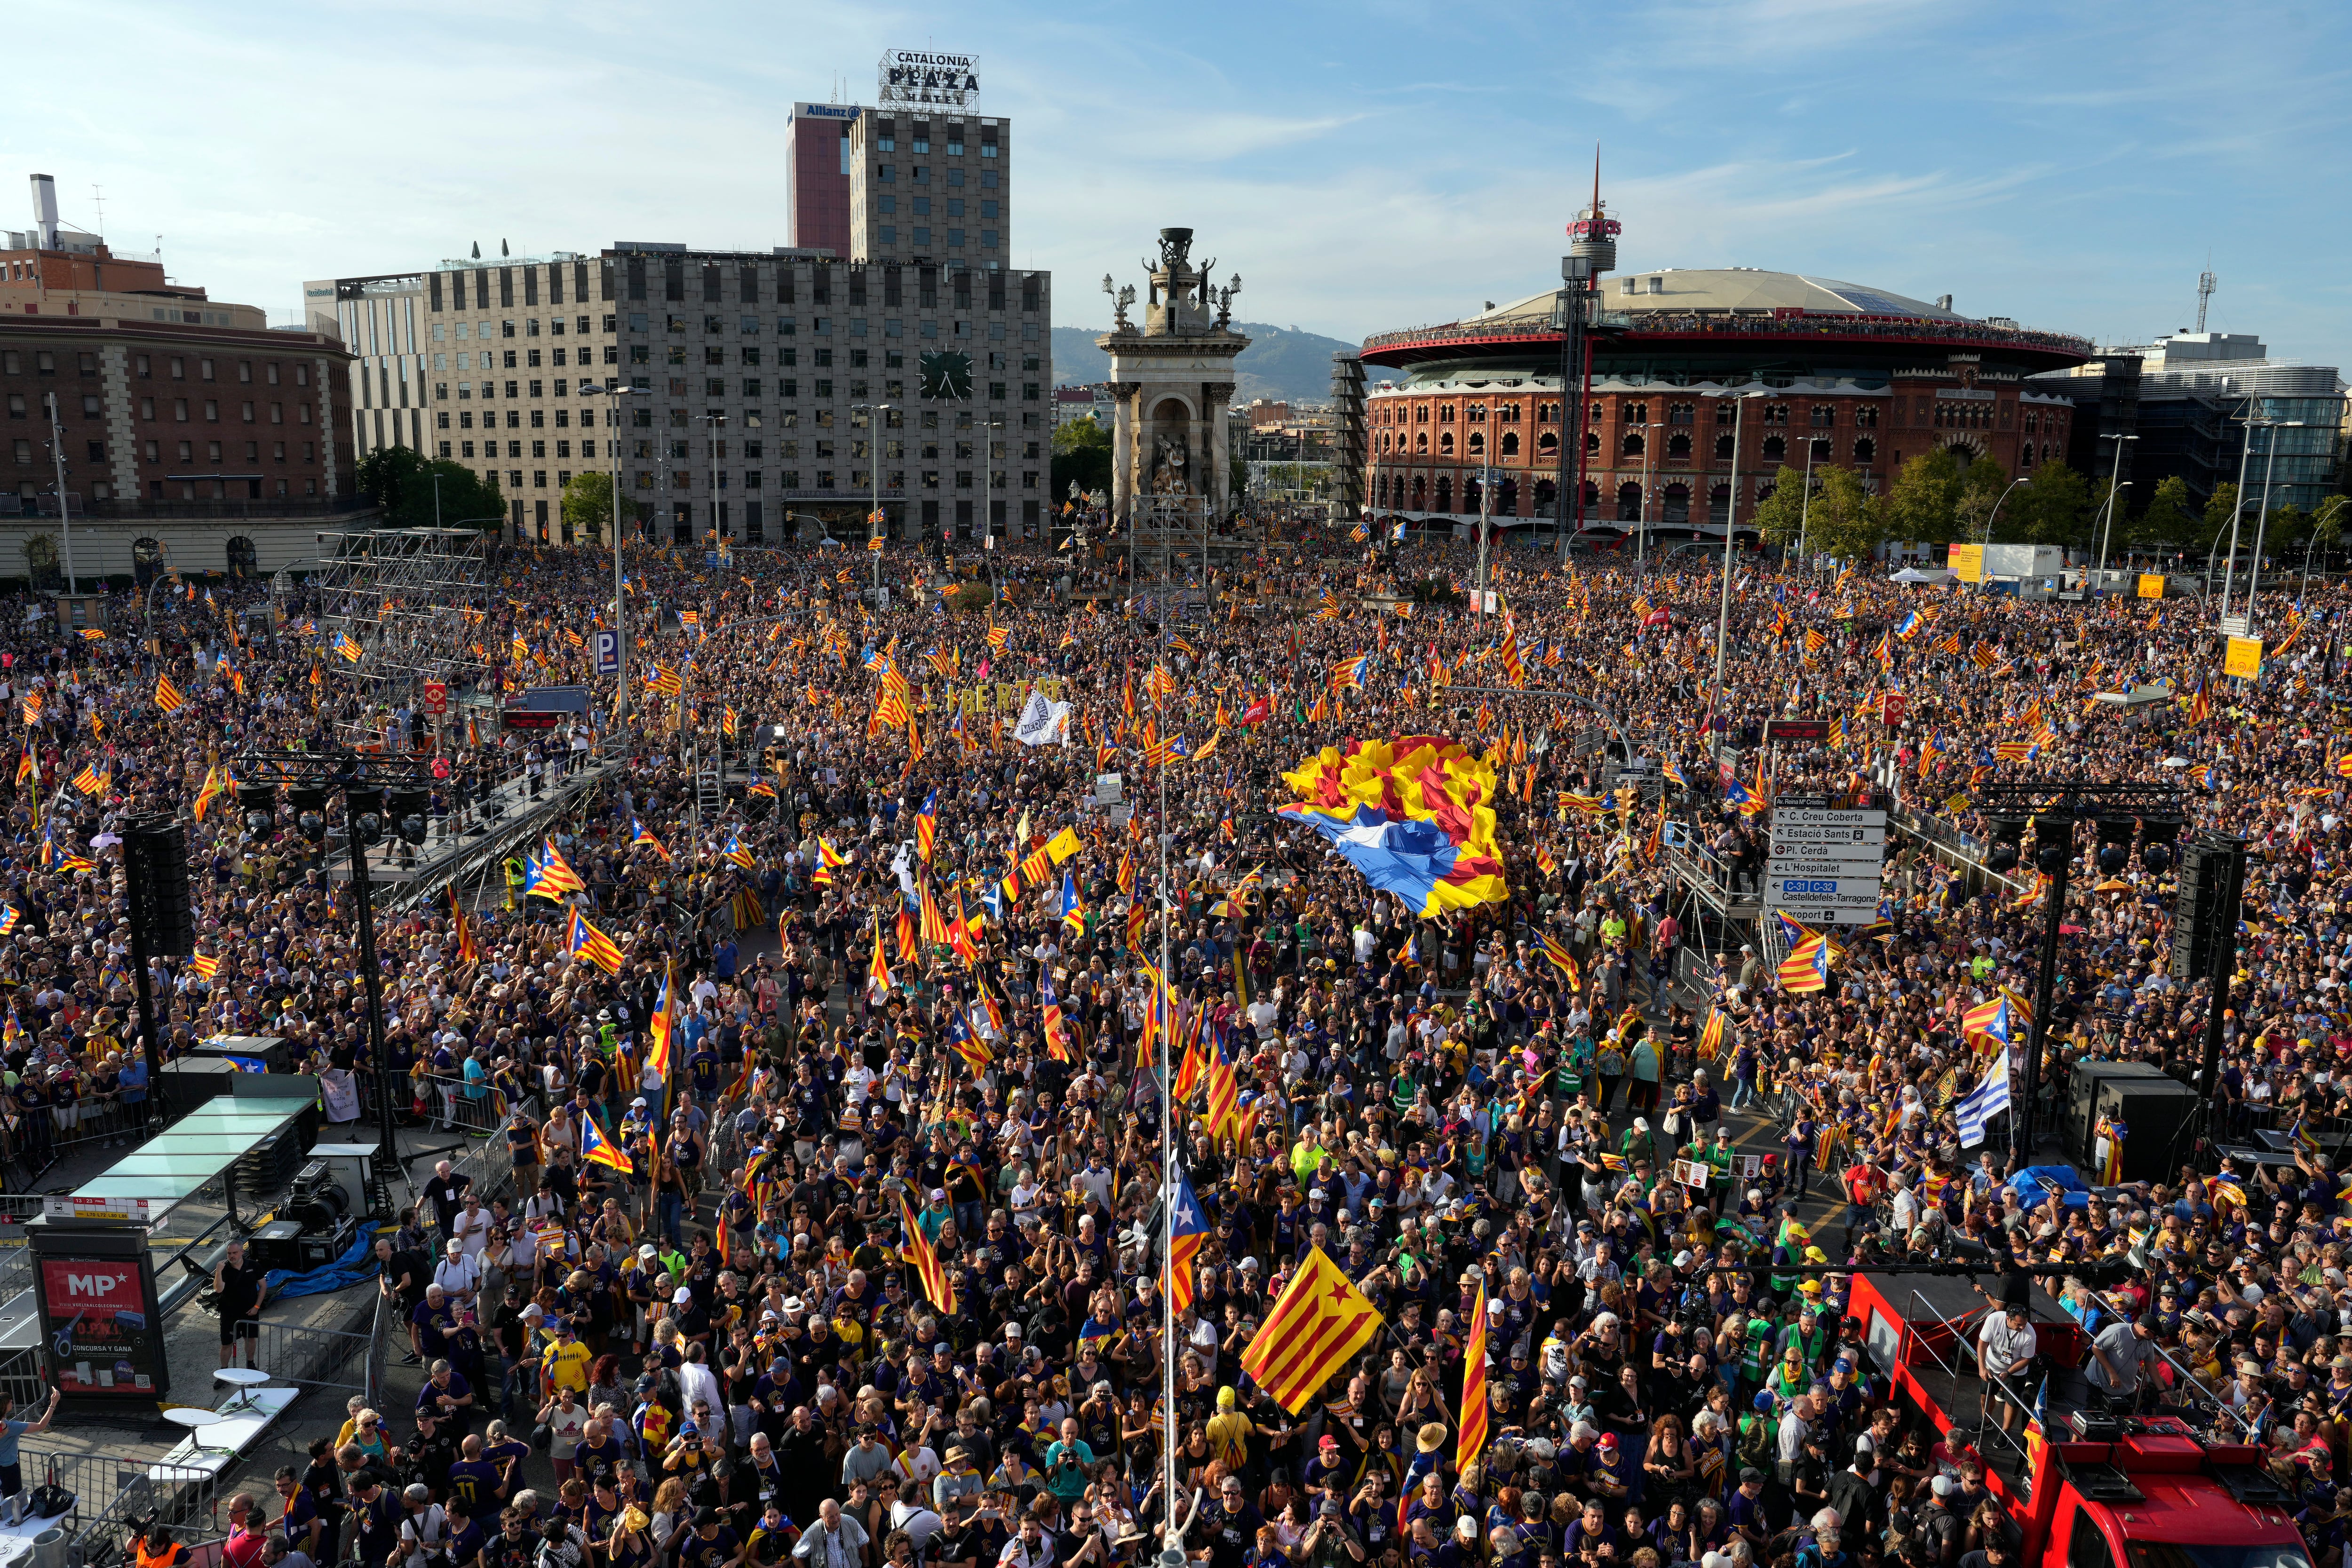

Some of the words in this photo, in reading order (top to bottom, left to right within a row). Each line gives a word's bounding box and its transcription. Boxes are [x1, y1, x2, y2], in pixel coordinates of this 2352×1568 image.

[898, 52, 970, 66] CATALONIA
[900, 64, 968, 74] BARCELONA
[890, 68, 979, 91] PLAZA
[908, 93, 962, 104] HOTEL
[807, 105, 846, 117] Allianz
[598, 634, 614, 663] P
[903, 677, 1063, 717] LLIBERTAT
[1723, 771, 1731, 780] MP
[1790, 812, 1799, 820] C.
[1802, 812, 1823, 821] Creu
[1827, 812, 1863, 822] Coberta
[1788, 828, 1821, 838] Estació
[1824, 829, 1850, 838] Sants
[1786, 846, 1797, 854] Pl.
[1801, 846, 1828, 855] Cerdà
[1785, 863, 1840, 873] L'Hospitalet
[1787, 882, 1805, 891] C-31
[1813, 882, 1833, 891] C-32
[1782, 892, 1876, 904] Castelldefels-Tarragona
[698, 1063, 709, 1076] 11
[329, 1100, 355, 1110] President
[68, 1274, 116, 1297] MP
[456, 1482, 475, 1504] 11
